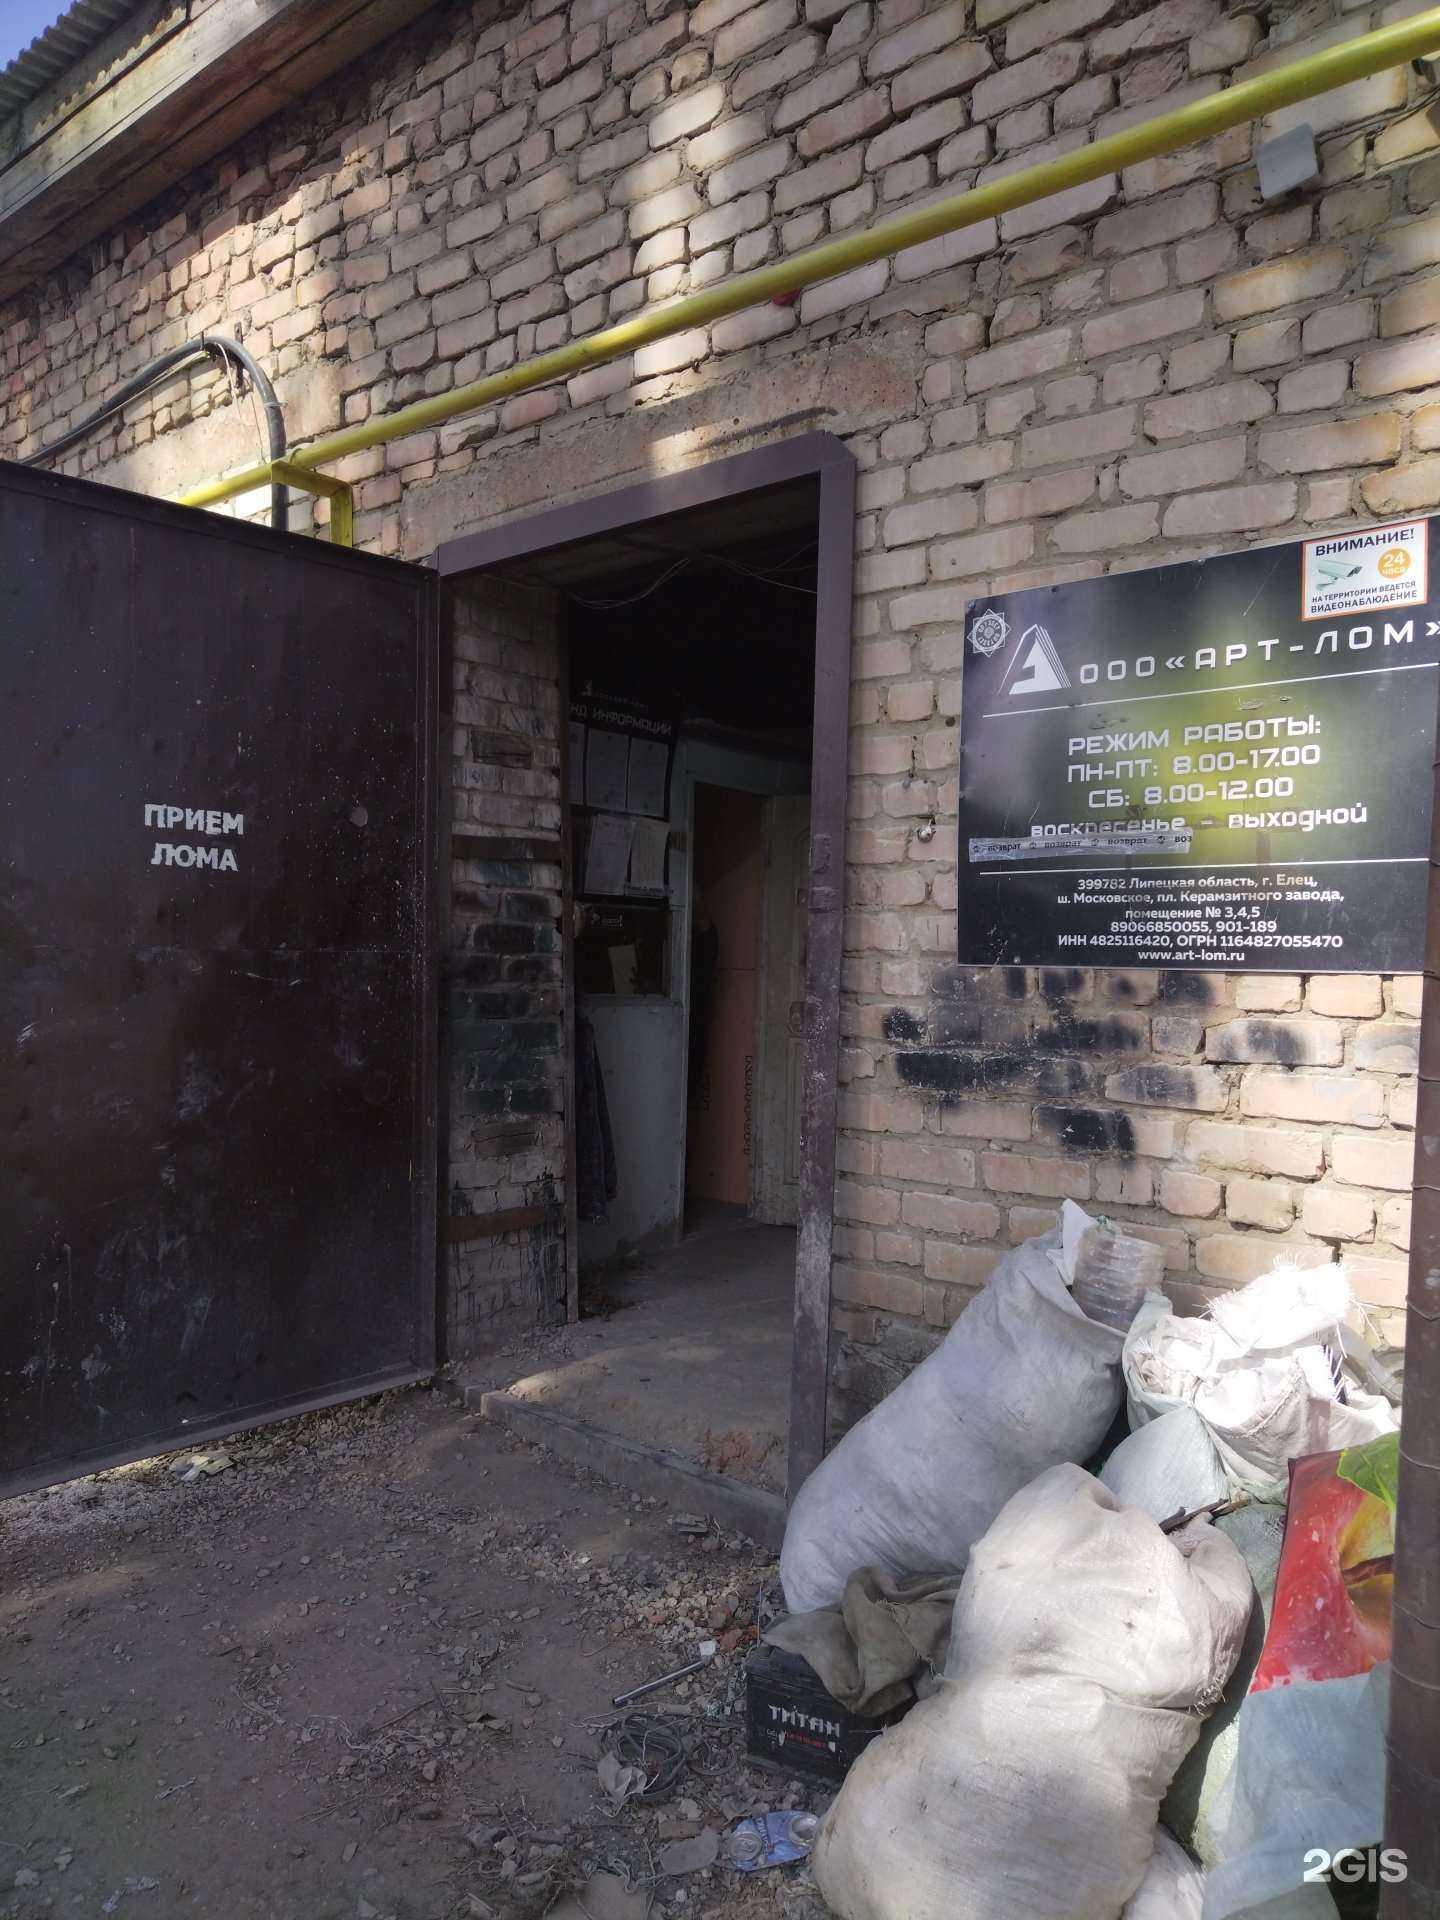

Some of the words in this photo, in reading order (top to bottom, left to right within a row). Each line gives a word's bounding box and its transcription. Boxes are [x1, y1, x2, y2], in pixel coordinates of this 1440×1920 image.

[1316, 528, 1415, 556] ВНИМАНИЕ!
[1383, 551, 1405, 567] 24
[1311, 590, 1417, 614] ВИДЕОНАБЛЮДЕНИЕ
[1312, 595, 1323, 603] НА
[1324, 587, 1377, 601] ТЕРРИТОРИИ
[1379, 581, 1416, 592] ВЕДЕТСЯ
[1068, 729, 1169, 756] РЕЖИМ
[1184, 714, 1321, 746] РАБОТЫ:
[1067, 758, 1158, 783] ПН-ПТ:
[1173, 744, 1320, 775] 8.00-17.00
[1089, 789, 1130, 808] СБ:
[1144, 776, 1294, 805] 8.00-12.00
[144, 803, 244, 835] ПРИЕМ
[150, 842, 239, 872] ЛОМА
[1078, 878, 1126, 890] 399782
[1129, 878, 1195, 889] Липецкая
[1198, 876, 1258, 888] область,
[1276, 874, 1319, 887] Елец,
[1057, 896, 1071, 904] ш.
[1073, 893, 1154, 904] Московское,
[1157, 894, 1177, 902] пл.
[1180, 890, 1282, 904] Керамзитного
[1285, 890, 1345, 902] завода,
[1125, 909, 1202, 920] помещение
[1205, 906, 1222, 918] №
[1224, 906, 1261, 920] 3,4,5
[1110, 921, 1213, 934] 89066850055,
[1216, 920, 1278, 933] 901-189
[1058, 934, 1087, 946] ИНН
[1089, 935, 1174, 948] 4825116420,
[1176, 935, 1217, 947] ОГРН
[1220, 935, 1343, 948] 1164827055470
[1138, 949, 1245, 961] www.art-lom.ru
